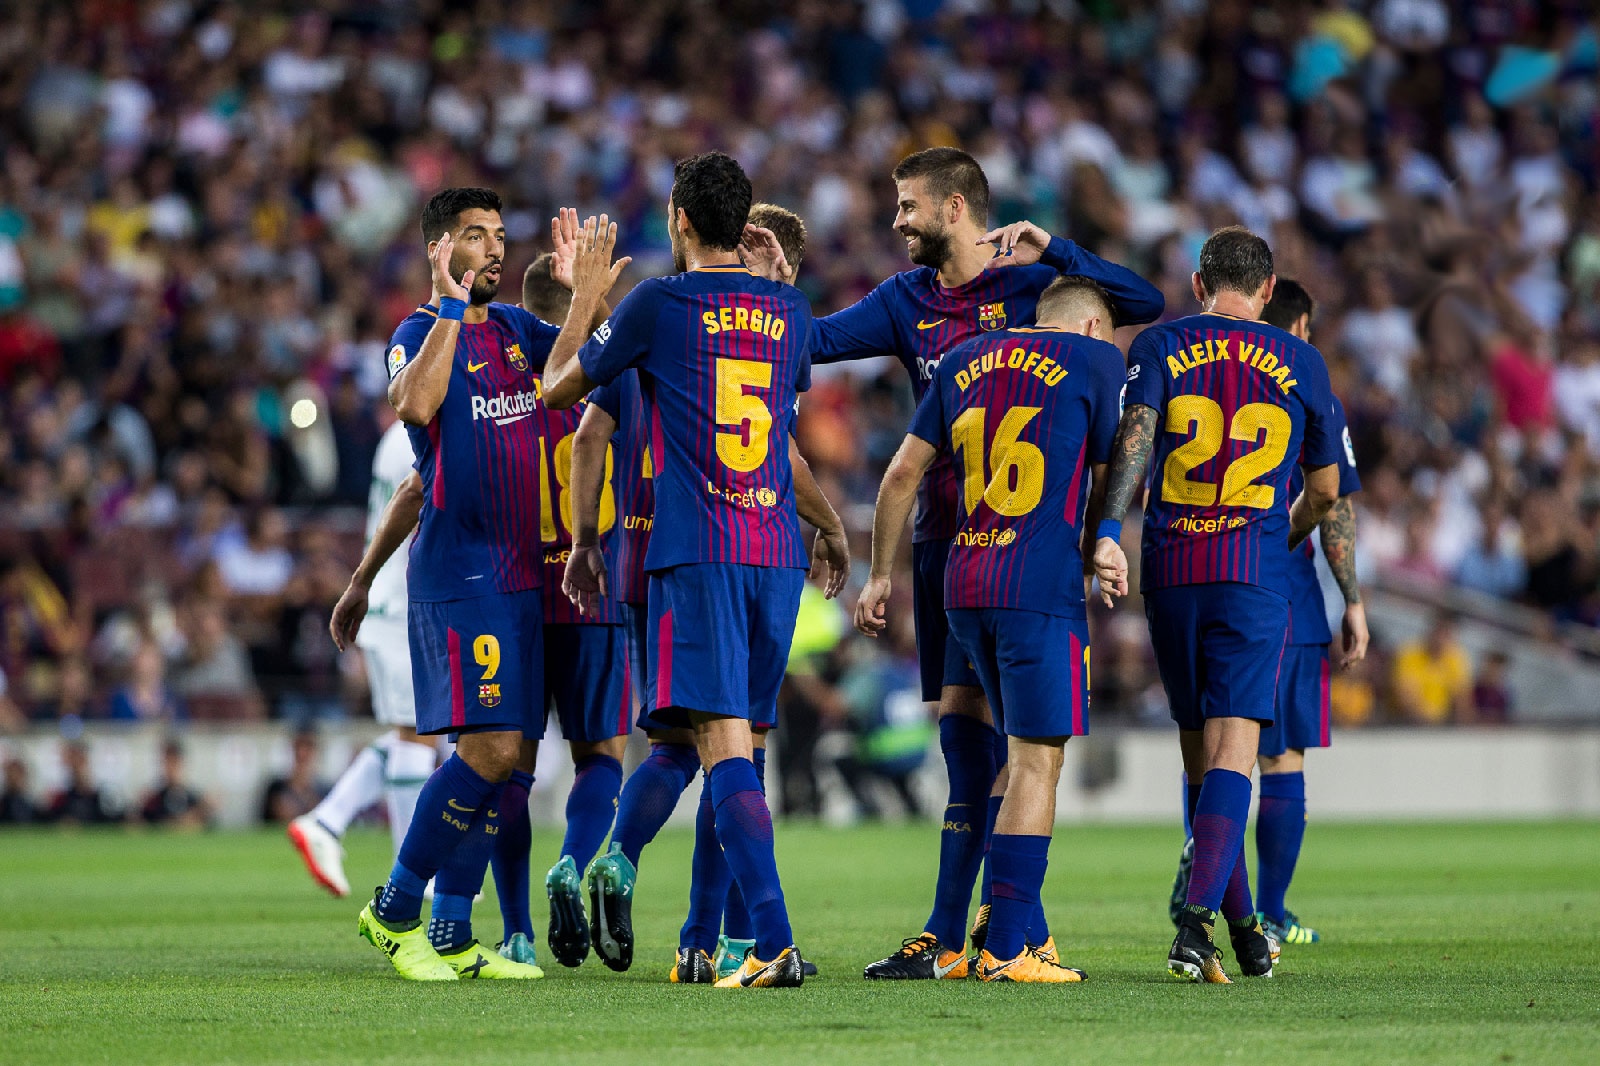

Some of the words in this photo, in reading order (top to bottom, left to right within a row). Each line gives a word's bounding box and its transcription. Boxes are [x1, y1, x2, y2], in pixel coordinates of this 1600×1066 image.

[703, 307, 785, 340] SERGIO
[954, 347, 1068, 392] DEULOFEU
[1165, 339, 1231, 379] ALEIX
[1237, 340, 1298, 396] VIDAL
[716, 358, 772, 472] 5
[951, 405, 1045, 517] 16
[1161, 394, 1292, 510] 22
[708, 481, 756, 508] uicef
[624, 513, 654, 532] uni
[953, 527, 999, 548] nicef
[473, 634, 501, 680] 9
